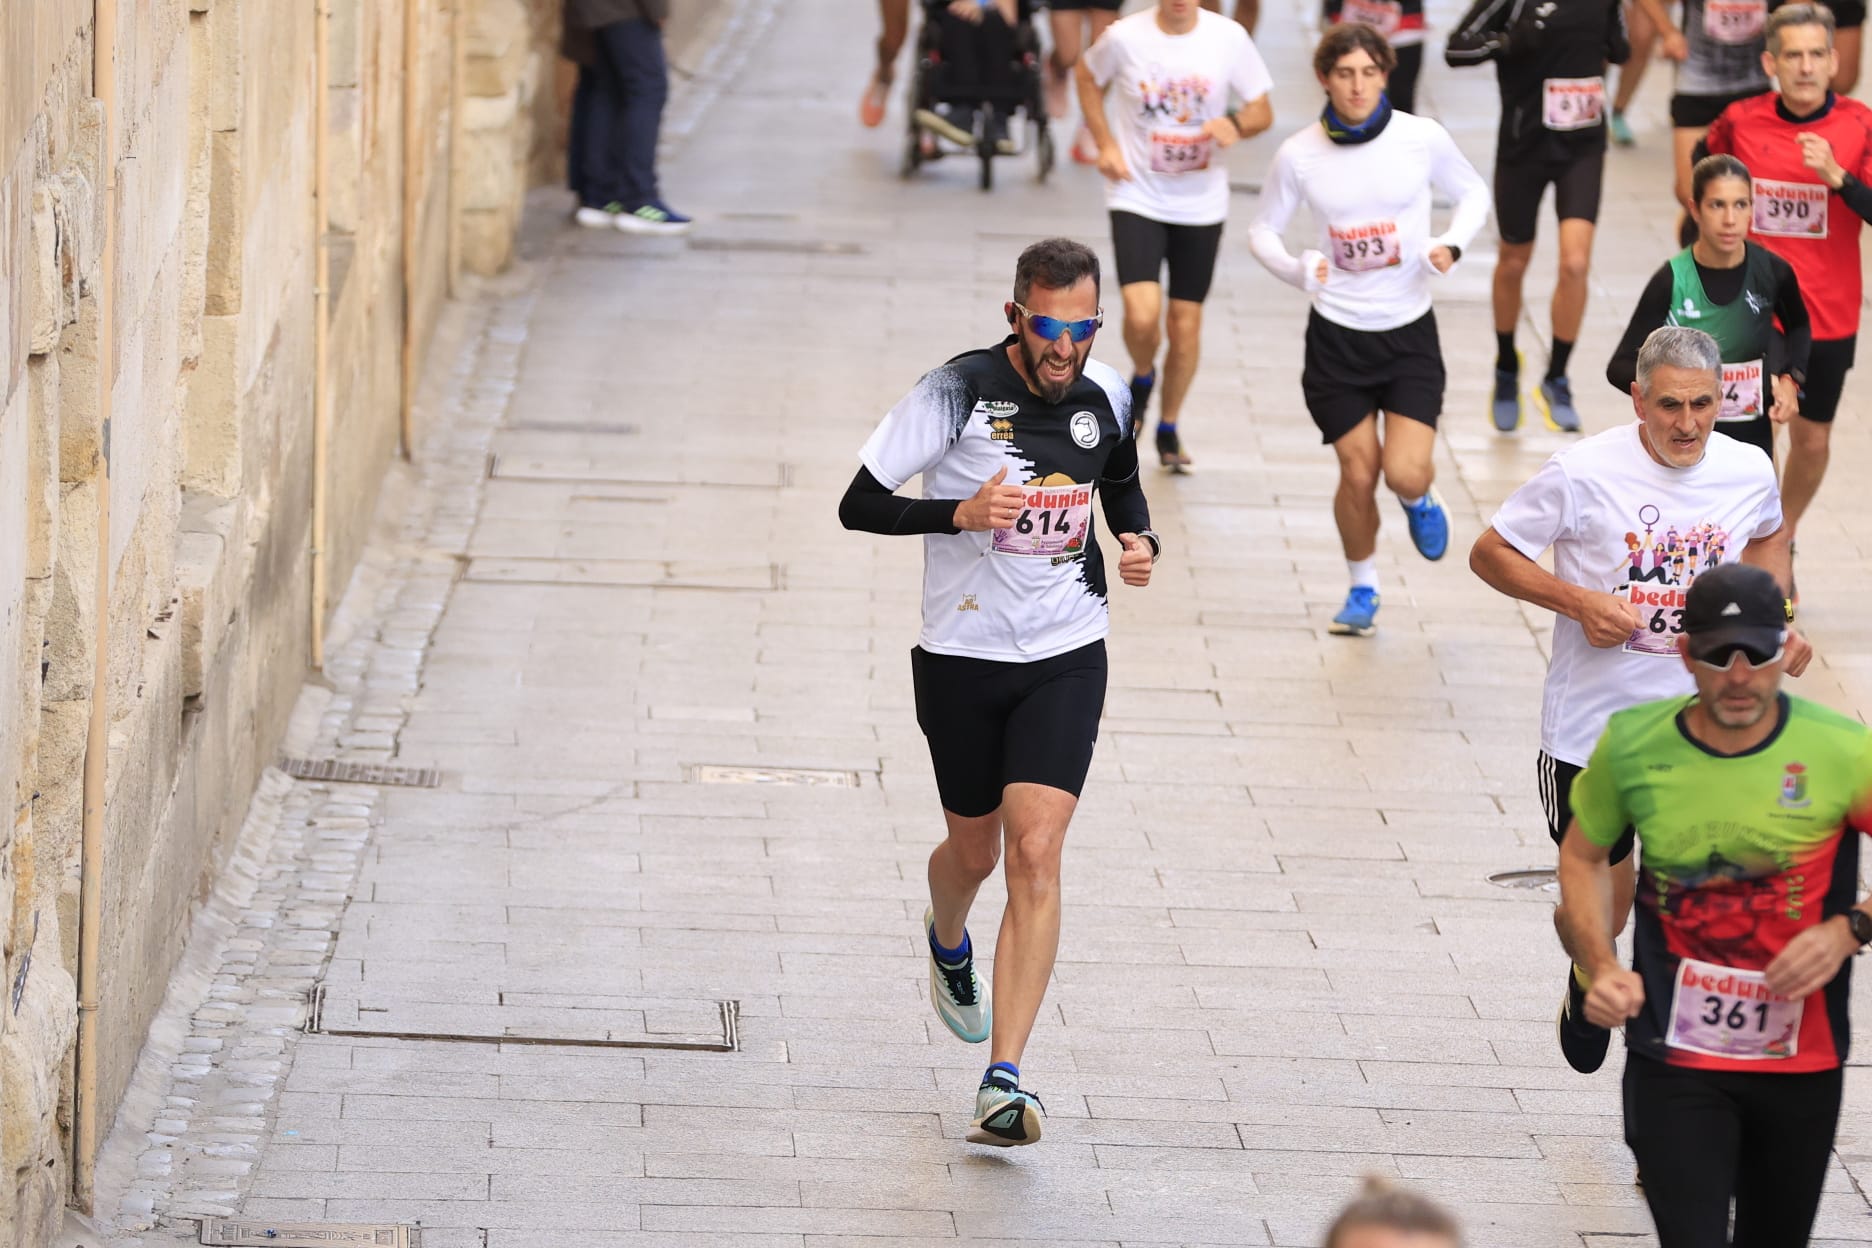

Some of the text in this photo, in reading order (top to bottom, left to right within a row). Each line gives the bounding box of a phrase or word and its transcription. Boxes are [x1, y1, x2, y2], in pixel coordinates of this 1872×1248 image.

[1767, 199, 1809, 219] 390
[1342, 237, 1385, 259] 393
[1723, 366, 1760, 381] unia
[1016, 509, 1071, 535] 614
[1630, 586, 1687, 608] bedu
[1649, 608, 1687, 635] 63
[1702, 996, 1769, 1032] 361
